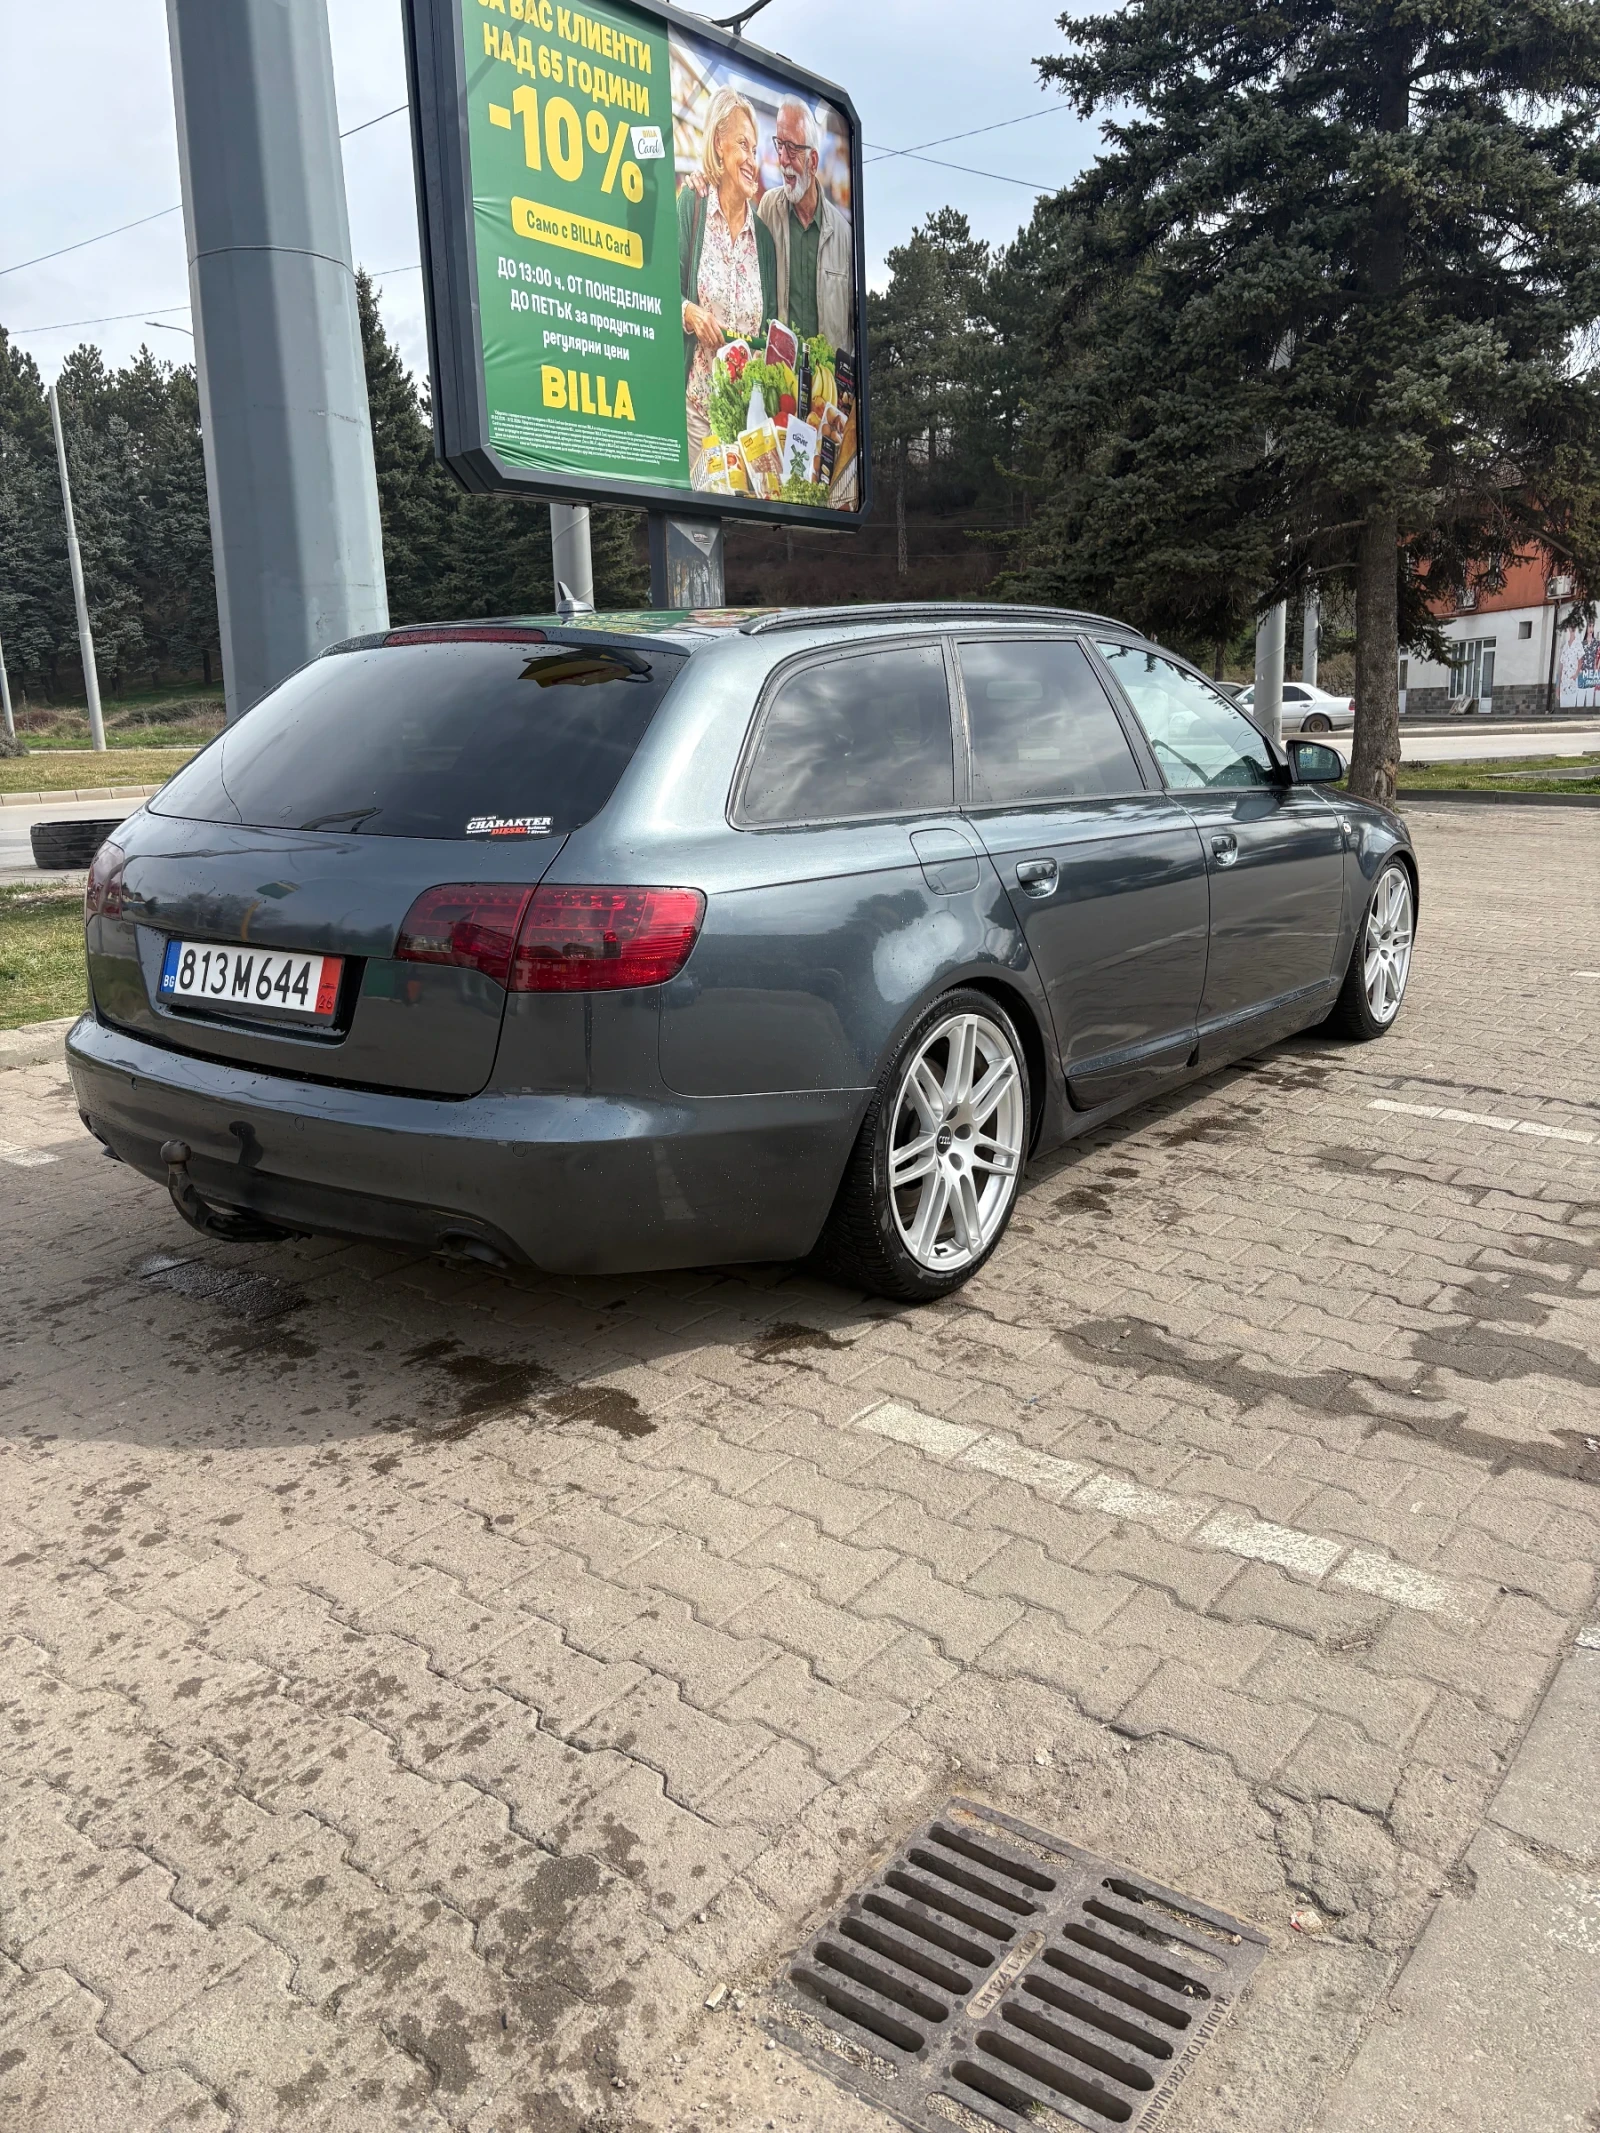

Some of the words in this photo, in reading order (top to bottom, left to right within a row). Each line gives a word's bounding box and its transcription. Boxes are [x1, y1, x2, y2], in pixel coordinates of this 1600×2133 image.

[556, 5, 652, 75] КЛИЕНТИ
[483, 22, 536, 80] НАД
[538, 45, 564, 83] 65
[566, 55, 650, 117] ГОДИНИ
[489, 84, 644, 203] -10%
[638, 138, 660, 155] Card
[526, 210, 559, 236] Само
[561, 225, 568, 239] с
[570, 222, 604, 249] BILLA
[605, 233, 631, 257] Card
[498, 256, 517, 280] ДО
[518, 262, 552, 287] 13:00
[554, 276, 565, 291] ч.
[567, 275, 583, 295] ОТ
[585, 279, 662, 315] ПОНЕДЕЛНИК
[510, 288, 529, 312] ДО
[531, 294, 573, 321] ПЕТЪК
[575, 309, 588, 324] за
[590, 313, 641, 337] продукти
[642, 326, 655, 340] на
[543, 330, 602, 357] регулярни
[603, 343, 630, 361] цени
[540, 364, 636, 421] BILLA
[467, 817, 552, 830] CHARAKTER
[491, 826, 527, 835] DIESEL
[163, 974, 175, 988] BG
[179, 949, 312, 1006] 813M644
[318, 994, 333, 1009] 26
